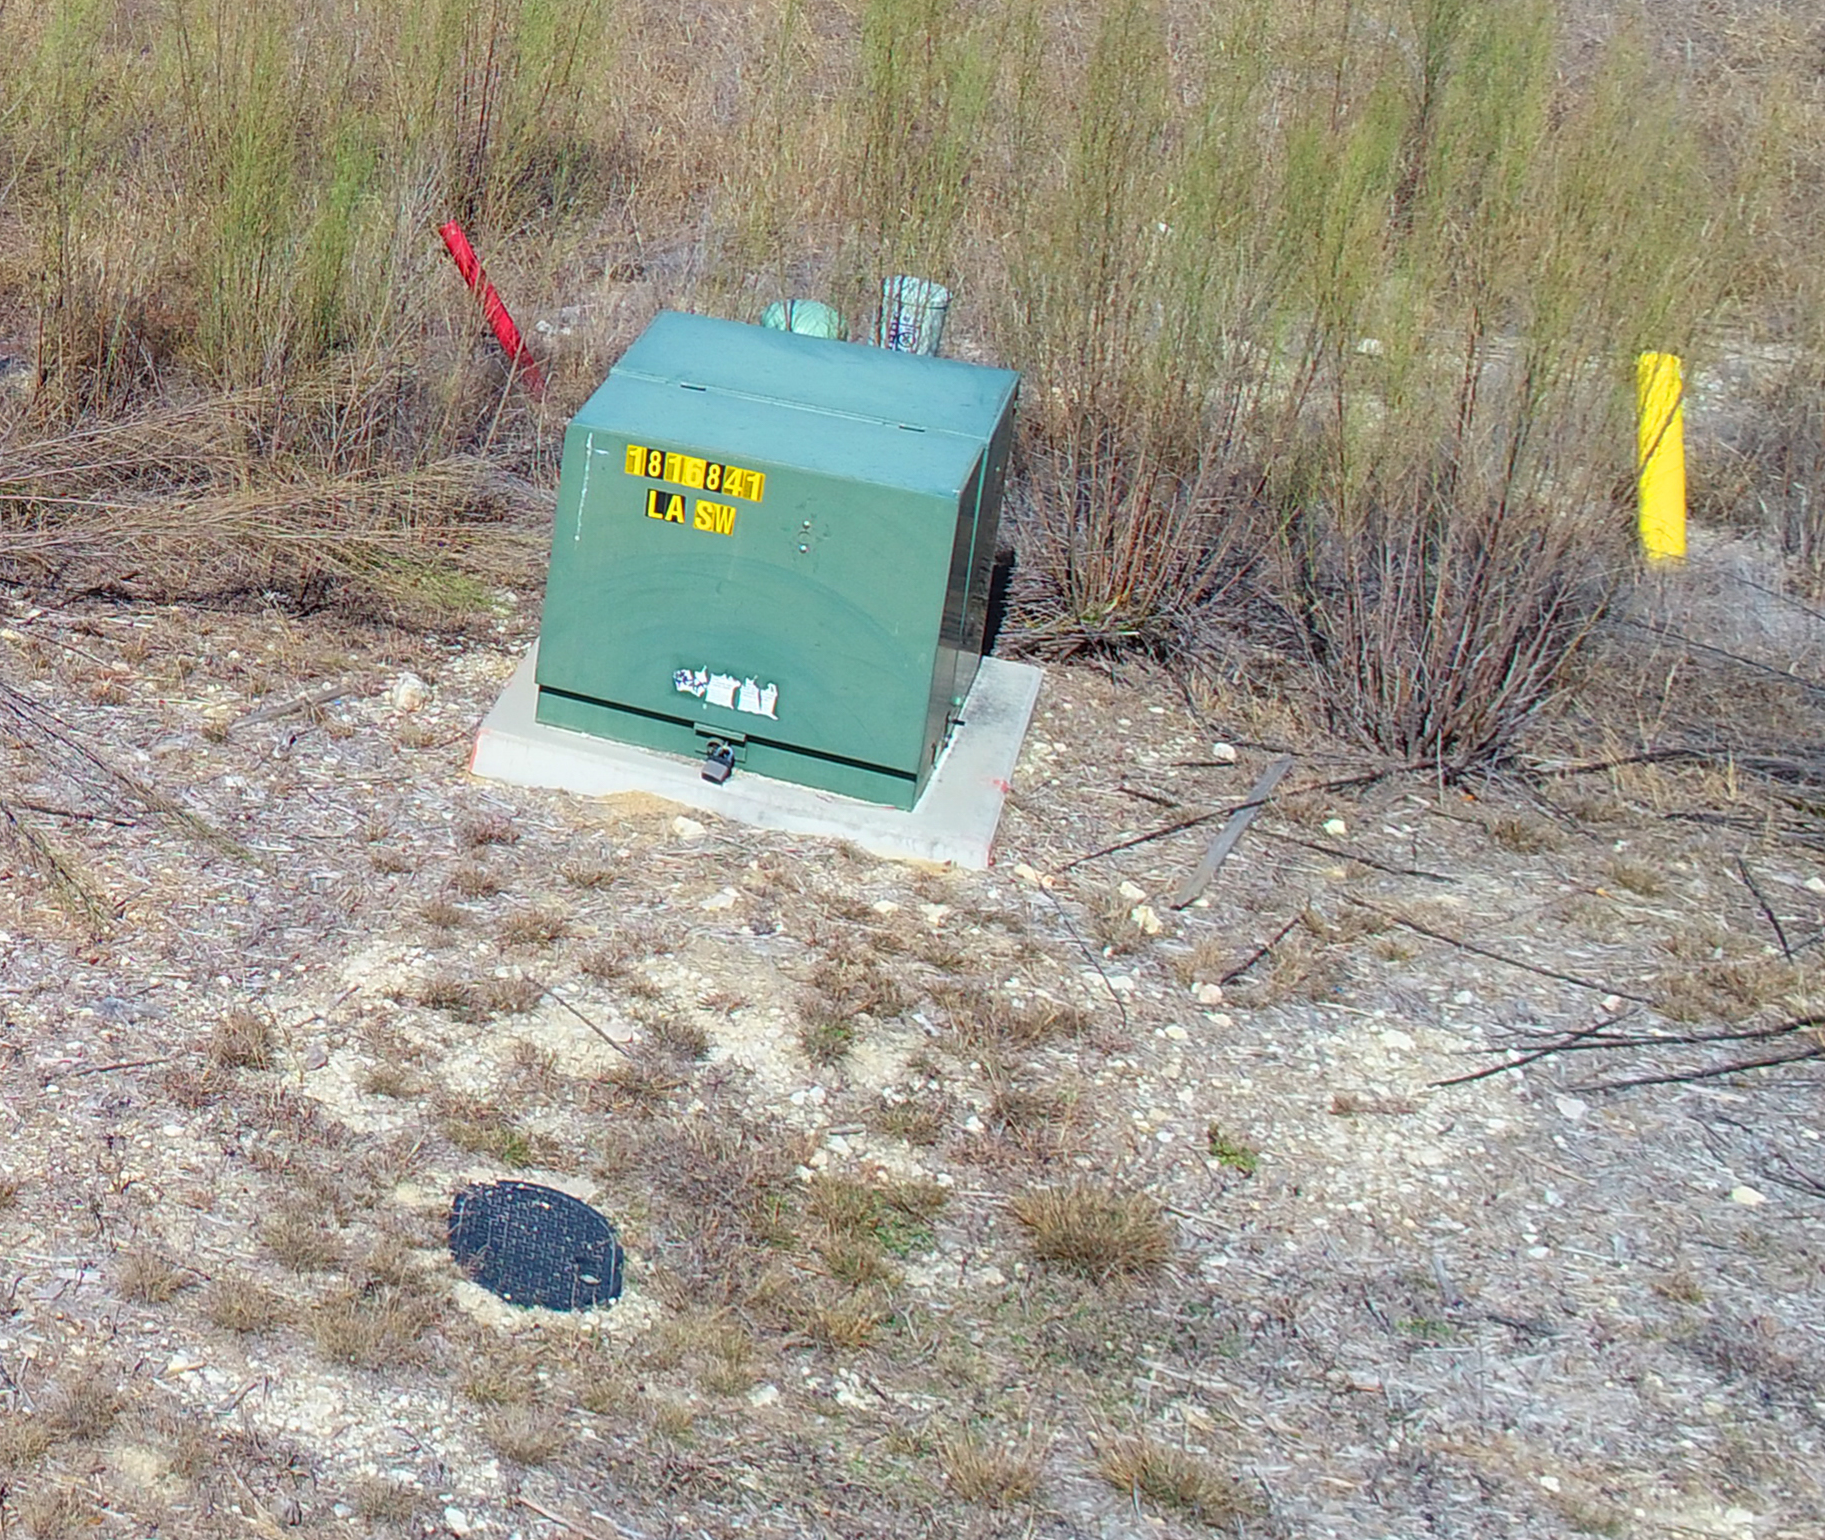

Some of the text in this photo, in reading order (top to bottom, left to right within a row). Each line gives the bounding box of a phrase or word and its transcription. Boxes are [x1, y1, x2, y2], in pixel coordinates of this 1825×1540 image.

[628, 446, 762, 501] 1816841
[647, 490, 736, 535] LA SW
